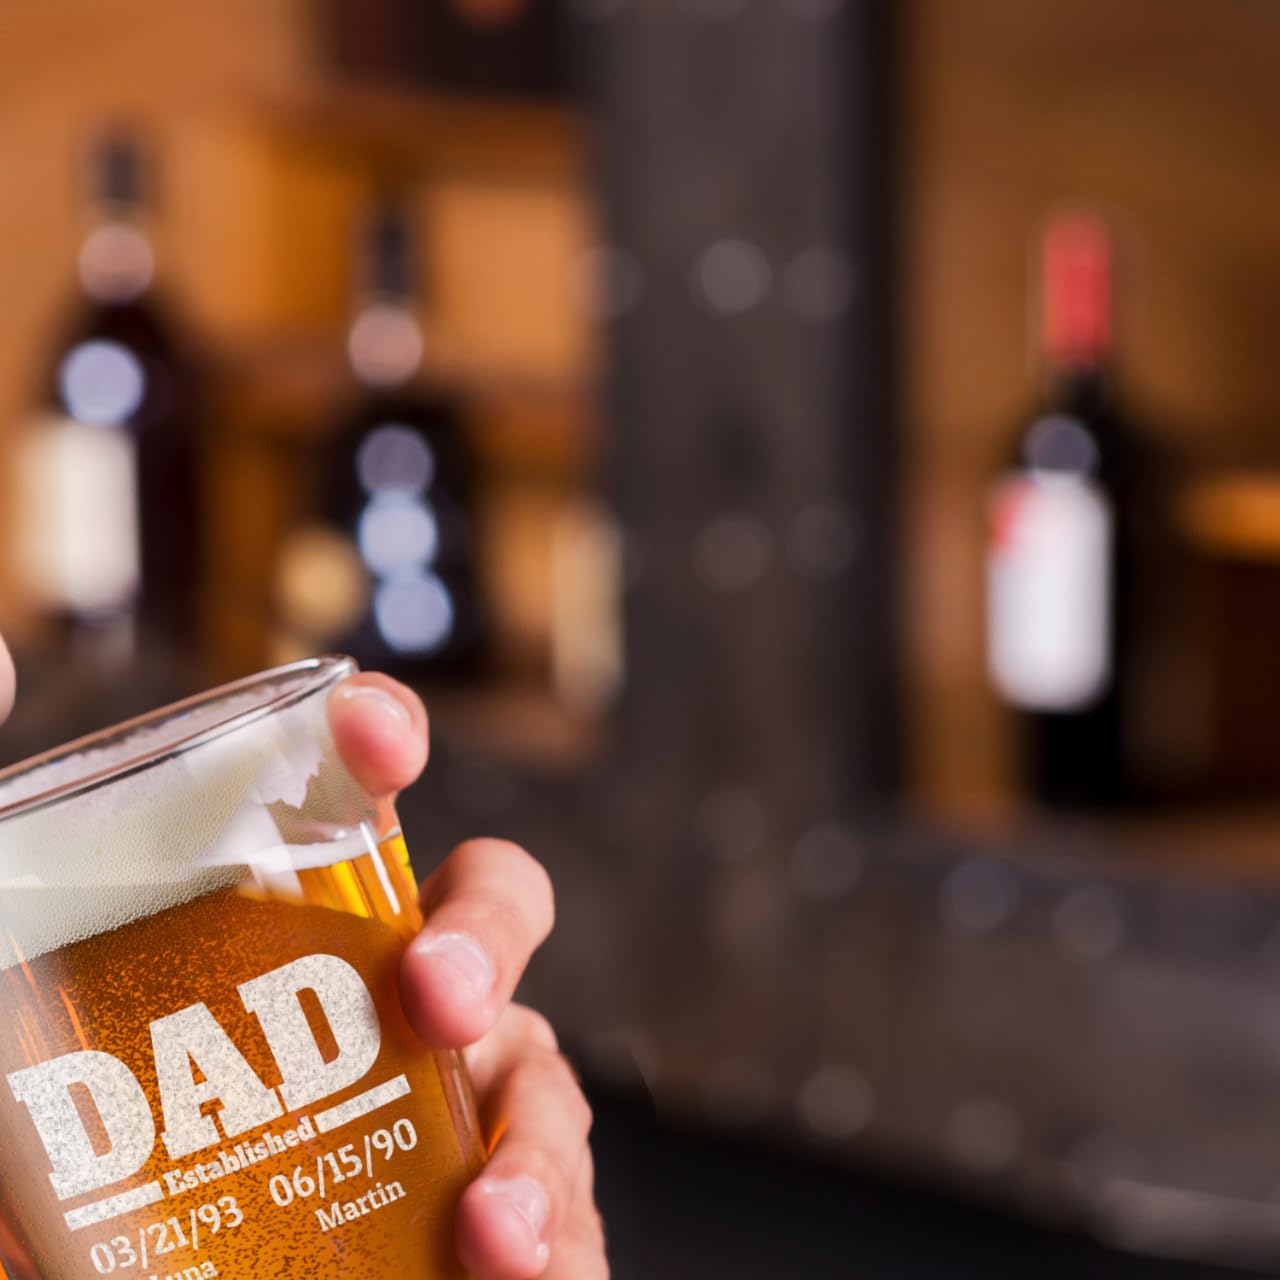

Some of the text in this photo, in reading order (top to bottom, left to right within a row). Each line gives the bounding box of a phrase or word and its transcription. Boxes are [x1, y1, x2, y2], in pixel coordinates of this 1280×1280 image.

[7, 953, 381, 1200] DAD
[89, 1118, 418, 1274] 03/21/93 06/15/90
[162, 1116, 317, 1196] Established
[314, 1178, 406, 1232] Martin
